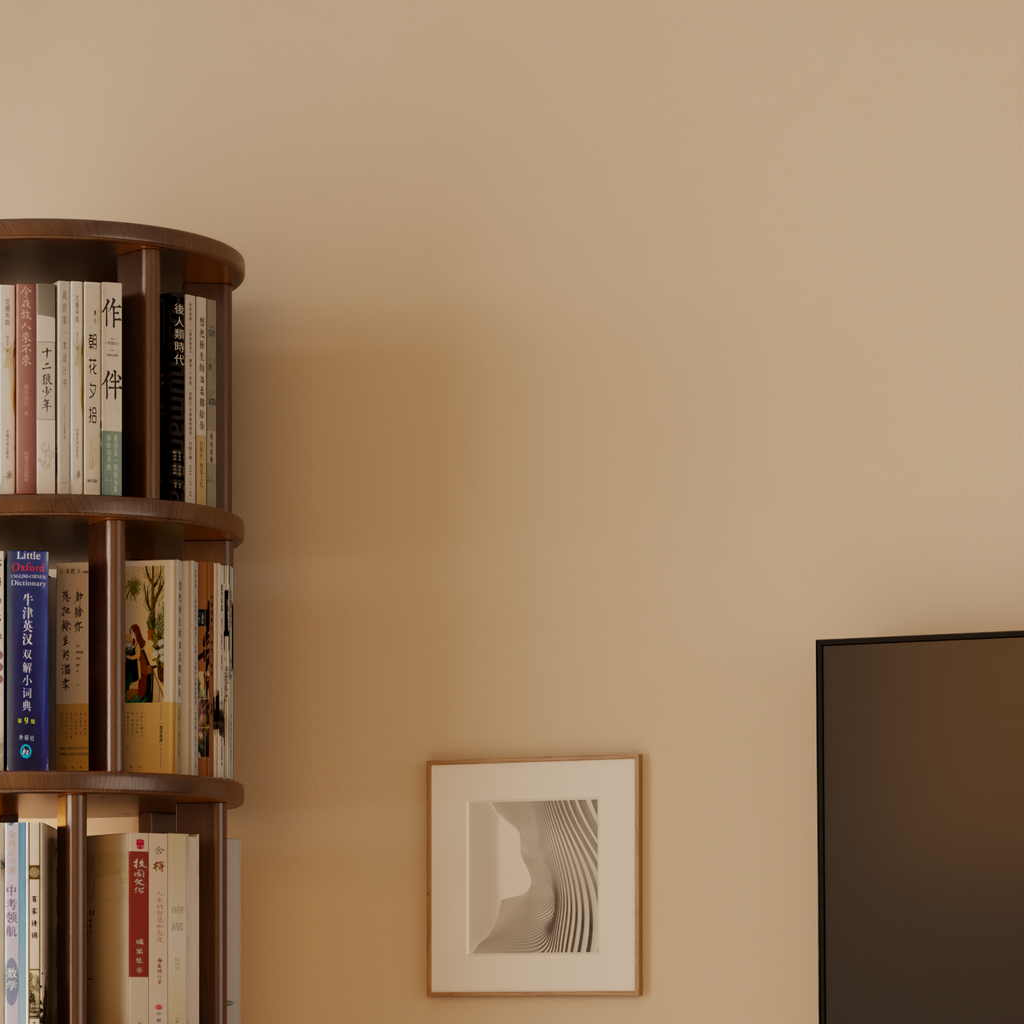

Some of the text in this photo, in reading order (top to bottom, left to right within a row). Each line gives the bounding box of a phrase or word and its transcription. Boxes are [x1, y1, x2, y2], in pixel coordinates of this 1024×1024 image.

[174, 302, 185, 367] 後人類時代
[41, 347, 53, 413] 十二狼少年
[88, 333, 98, 424] 朝花夕拾
[11, 562, 45, 573] Oxford
[16, 551, 41, 560] Little
[10, 579, 47, 589] Dictionary
[22, 592, 34, 712] 牛津英汉双解小词典
[18, 734, 35, 742] 外研社
[153, 845, 165, 873] 舍得
[6, 884, 18, 937] 中考领航
[6, 967, 18, 992] 数学
